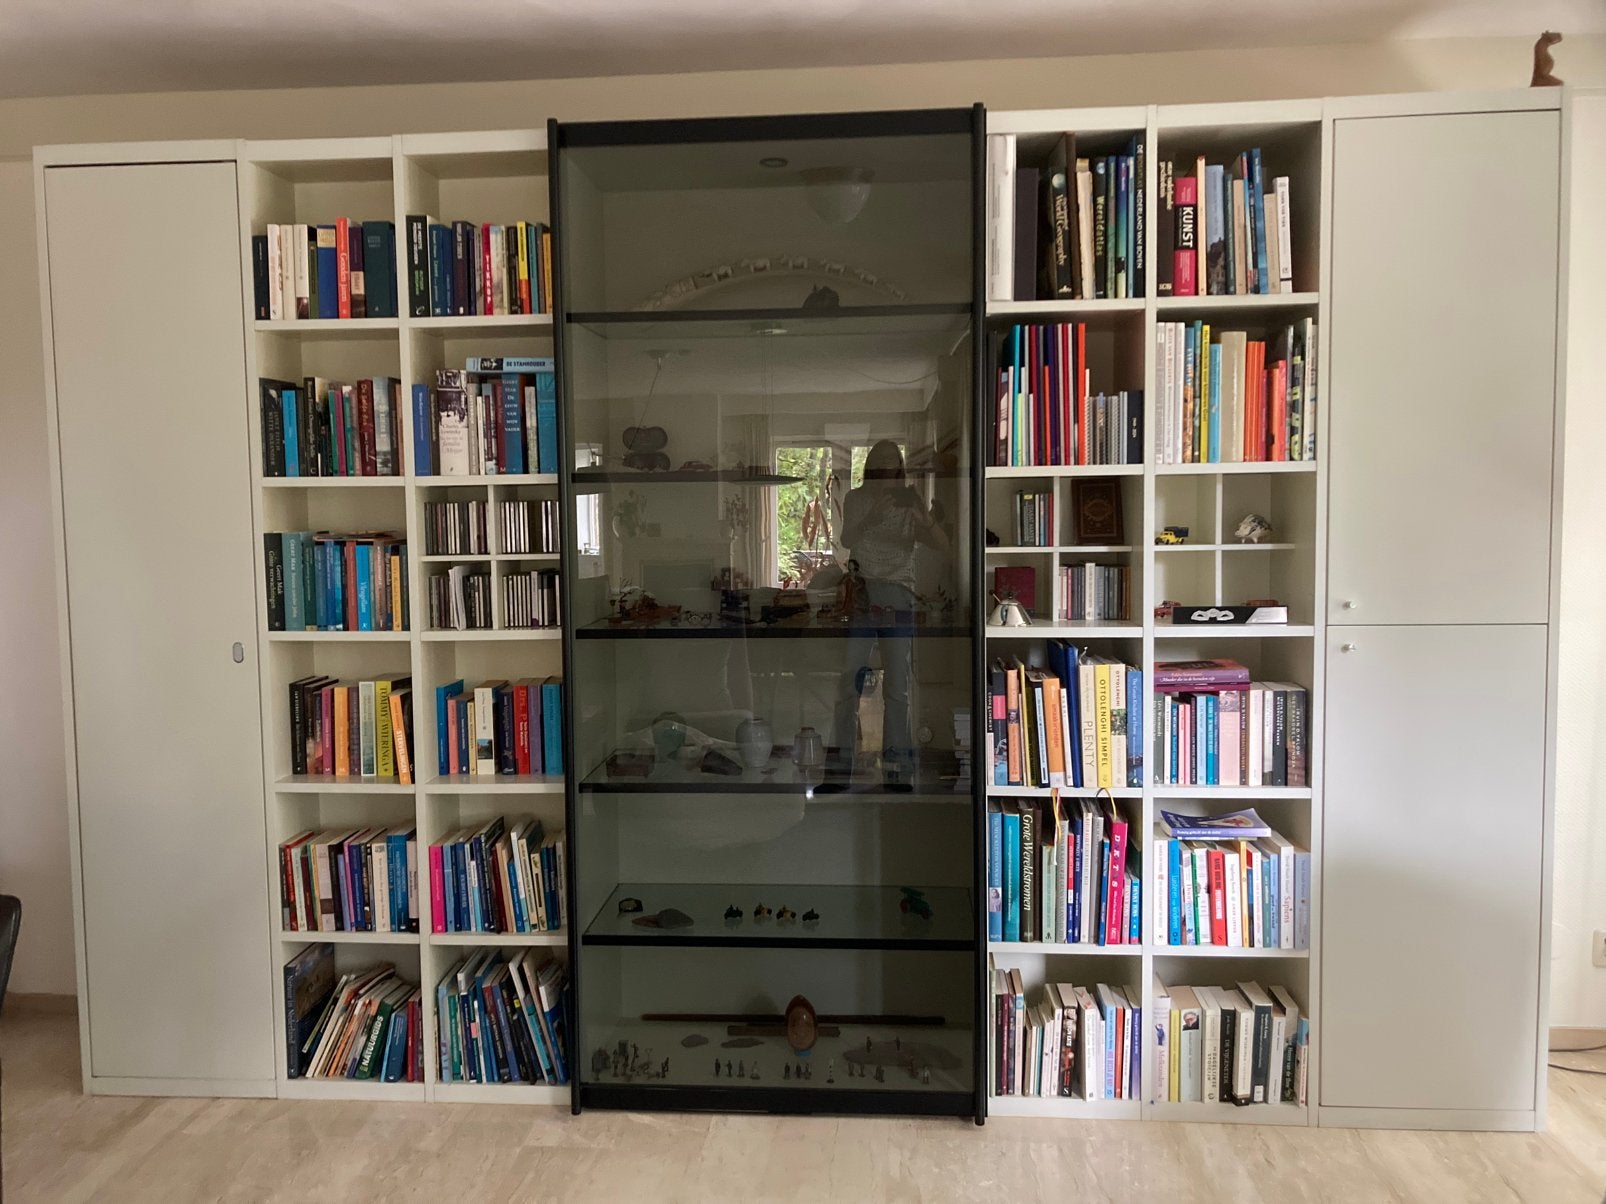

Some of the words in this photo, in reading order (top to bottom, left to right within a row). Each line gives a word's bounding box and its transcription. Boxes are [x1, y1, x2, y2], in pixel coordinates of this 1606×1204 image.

[1136, 144, 1143, 154] DE
[1056, 220, 1066, 266] Geography
[1096, 196, 1104, 256] Wereldatlas
[1182, 206, 1193, 248] KUNST
[380, 724, 390, 766] WIERINGA
[396, 730, 407, 773] STERVELINGEN
[1084, 720, 1094, 767] PLENTY
[1023, 814, 1033, 840] Grote
[1023, 842, 1034, 911] Wereldstromen
[1283, 896, 1292, 924] Sapiens
[362, 1016, 384, 1066] NATUURGIDS
